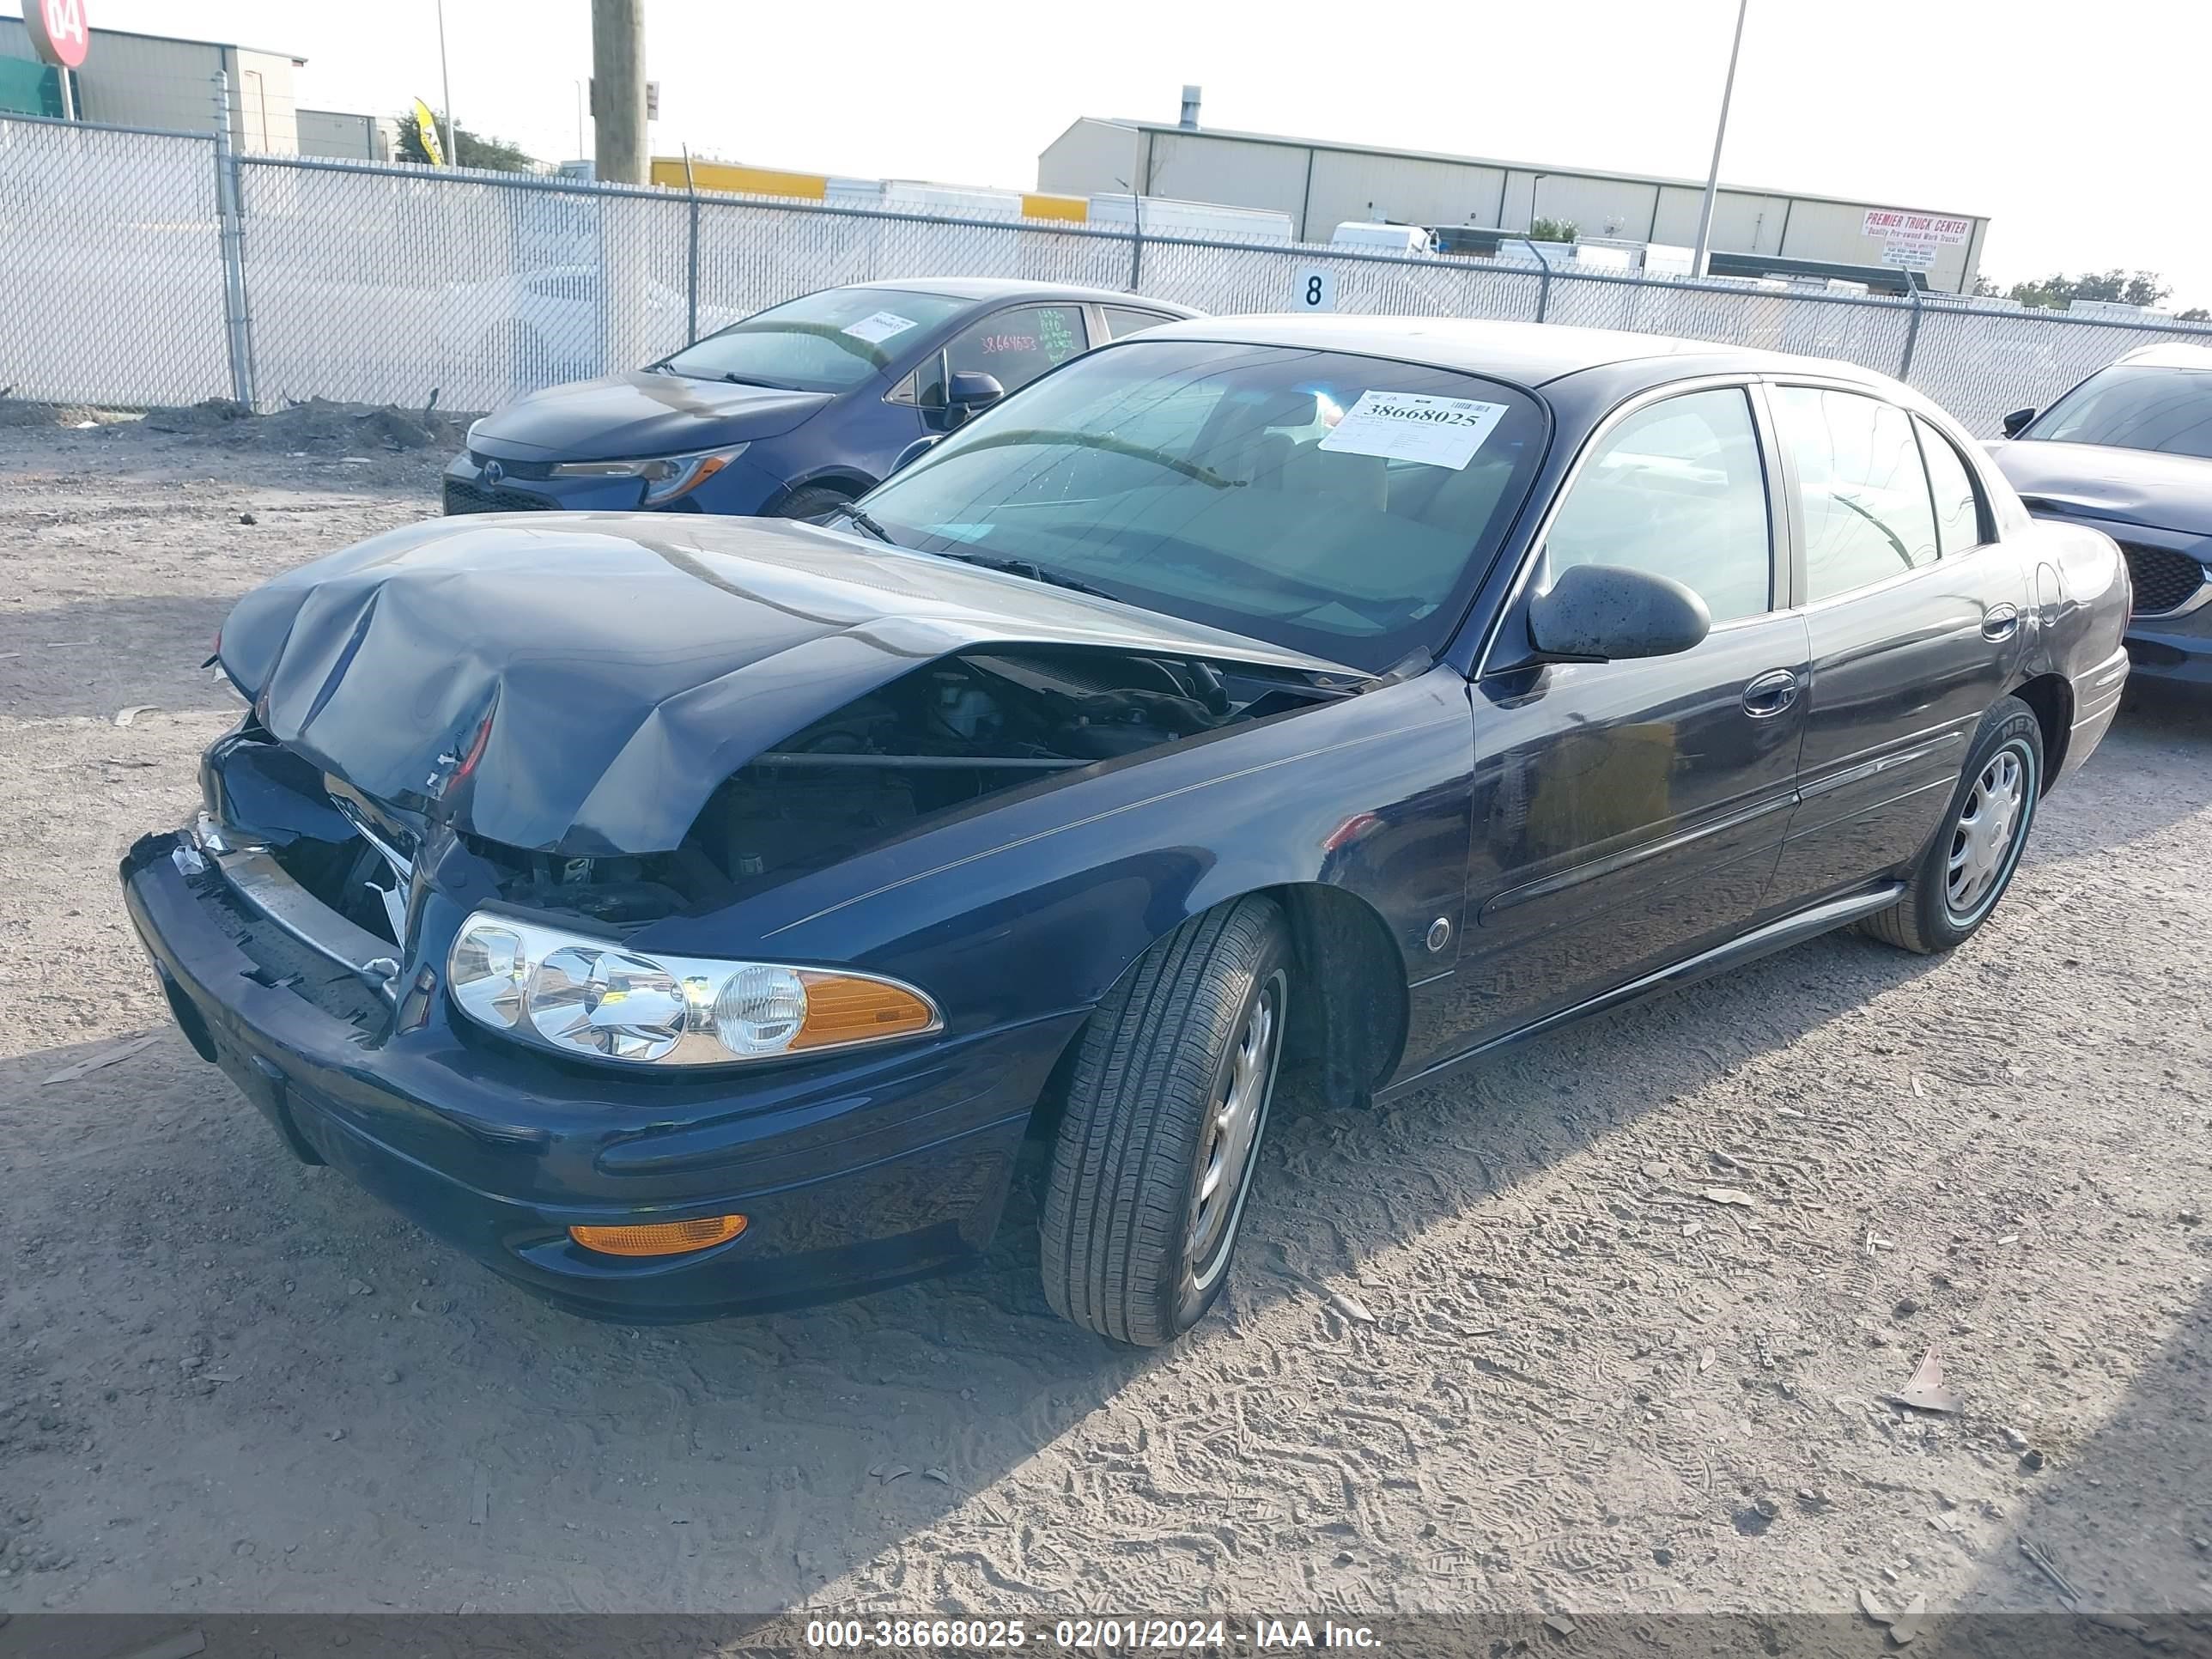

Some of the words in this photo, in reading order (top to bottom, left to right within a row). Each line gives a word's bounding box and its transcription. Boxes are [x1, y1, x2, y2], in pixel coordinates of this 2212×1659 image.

[1865, 212, 1904, 228] PREMIER
[1905, 216, 1934, 230] TRUCK
[1935, 219, 1968, 234] CENTER
[1306, 276, 1322, 306] 8
[1364, 404, 1481, 427] 38668025
